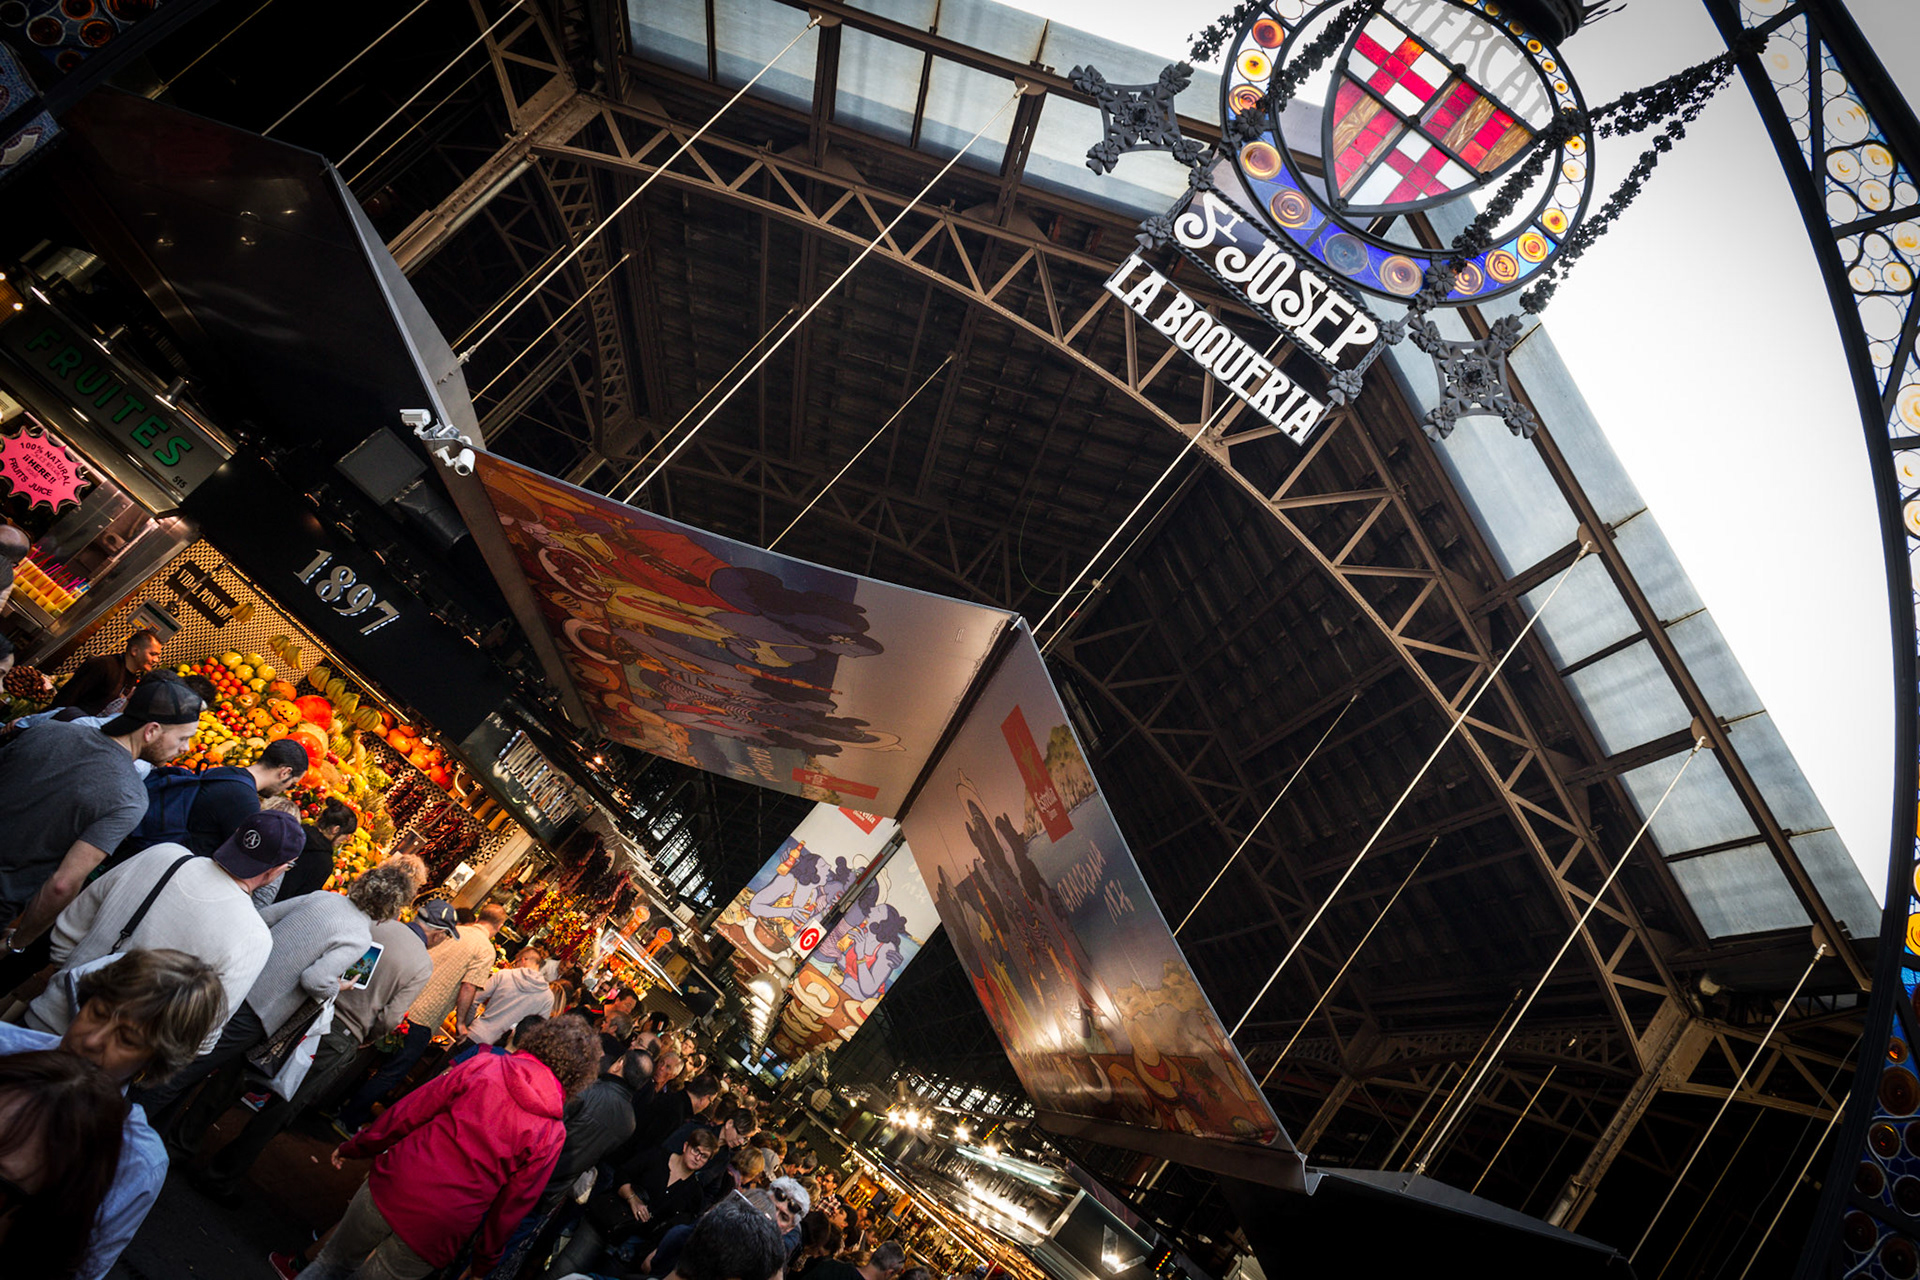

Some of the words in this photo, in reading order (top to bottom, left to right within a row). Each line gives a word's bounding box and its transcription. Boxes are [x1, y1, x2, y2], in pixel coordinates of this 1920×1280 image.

[1390, 0, 1551, 123] MERCAT
[1215, 238, 1379, 364] JOSEP
[1107, 254, 1168, 316] LA
[1152, 290, 1326, 445] BOQUERIA
[27, 328, 192, 466] FRUITES
[9, 457, 29, 483] FRUITS
[28, 482, 53, 497] JUICE
[20, 442, 44, 454] 100%
[44, 451, 71, 487] NATURAL
[172, 475, 188, 489] 515
[197, 587, 221, 610] PONS
[293, 549, 400, 636] 1897
[803, 931, 818, 948] 6
